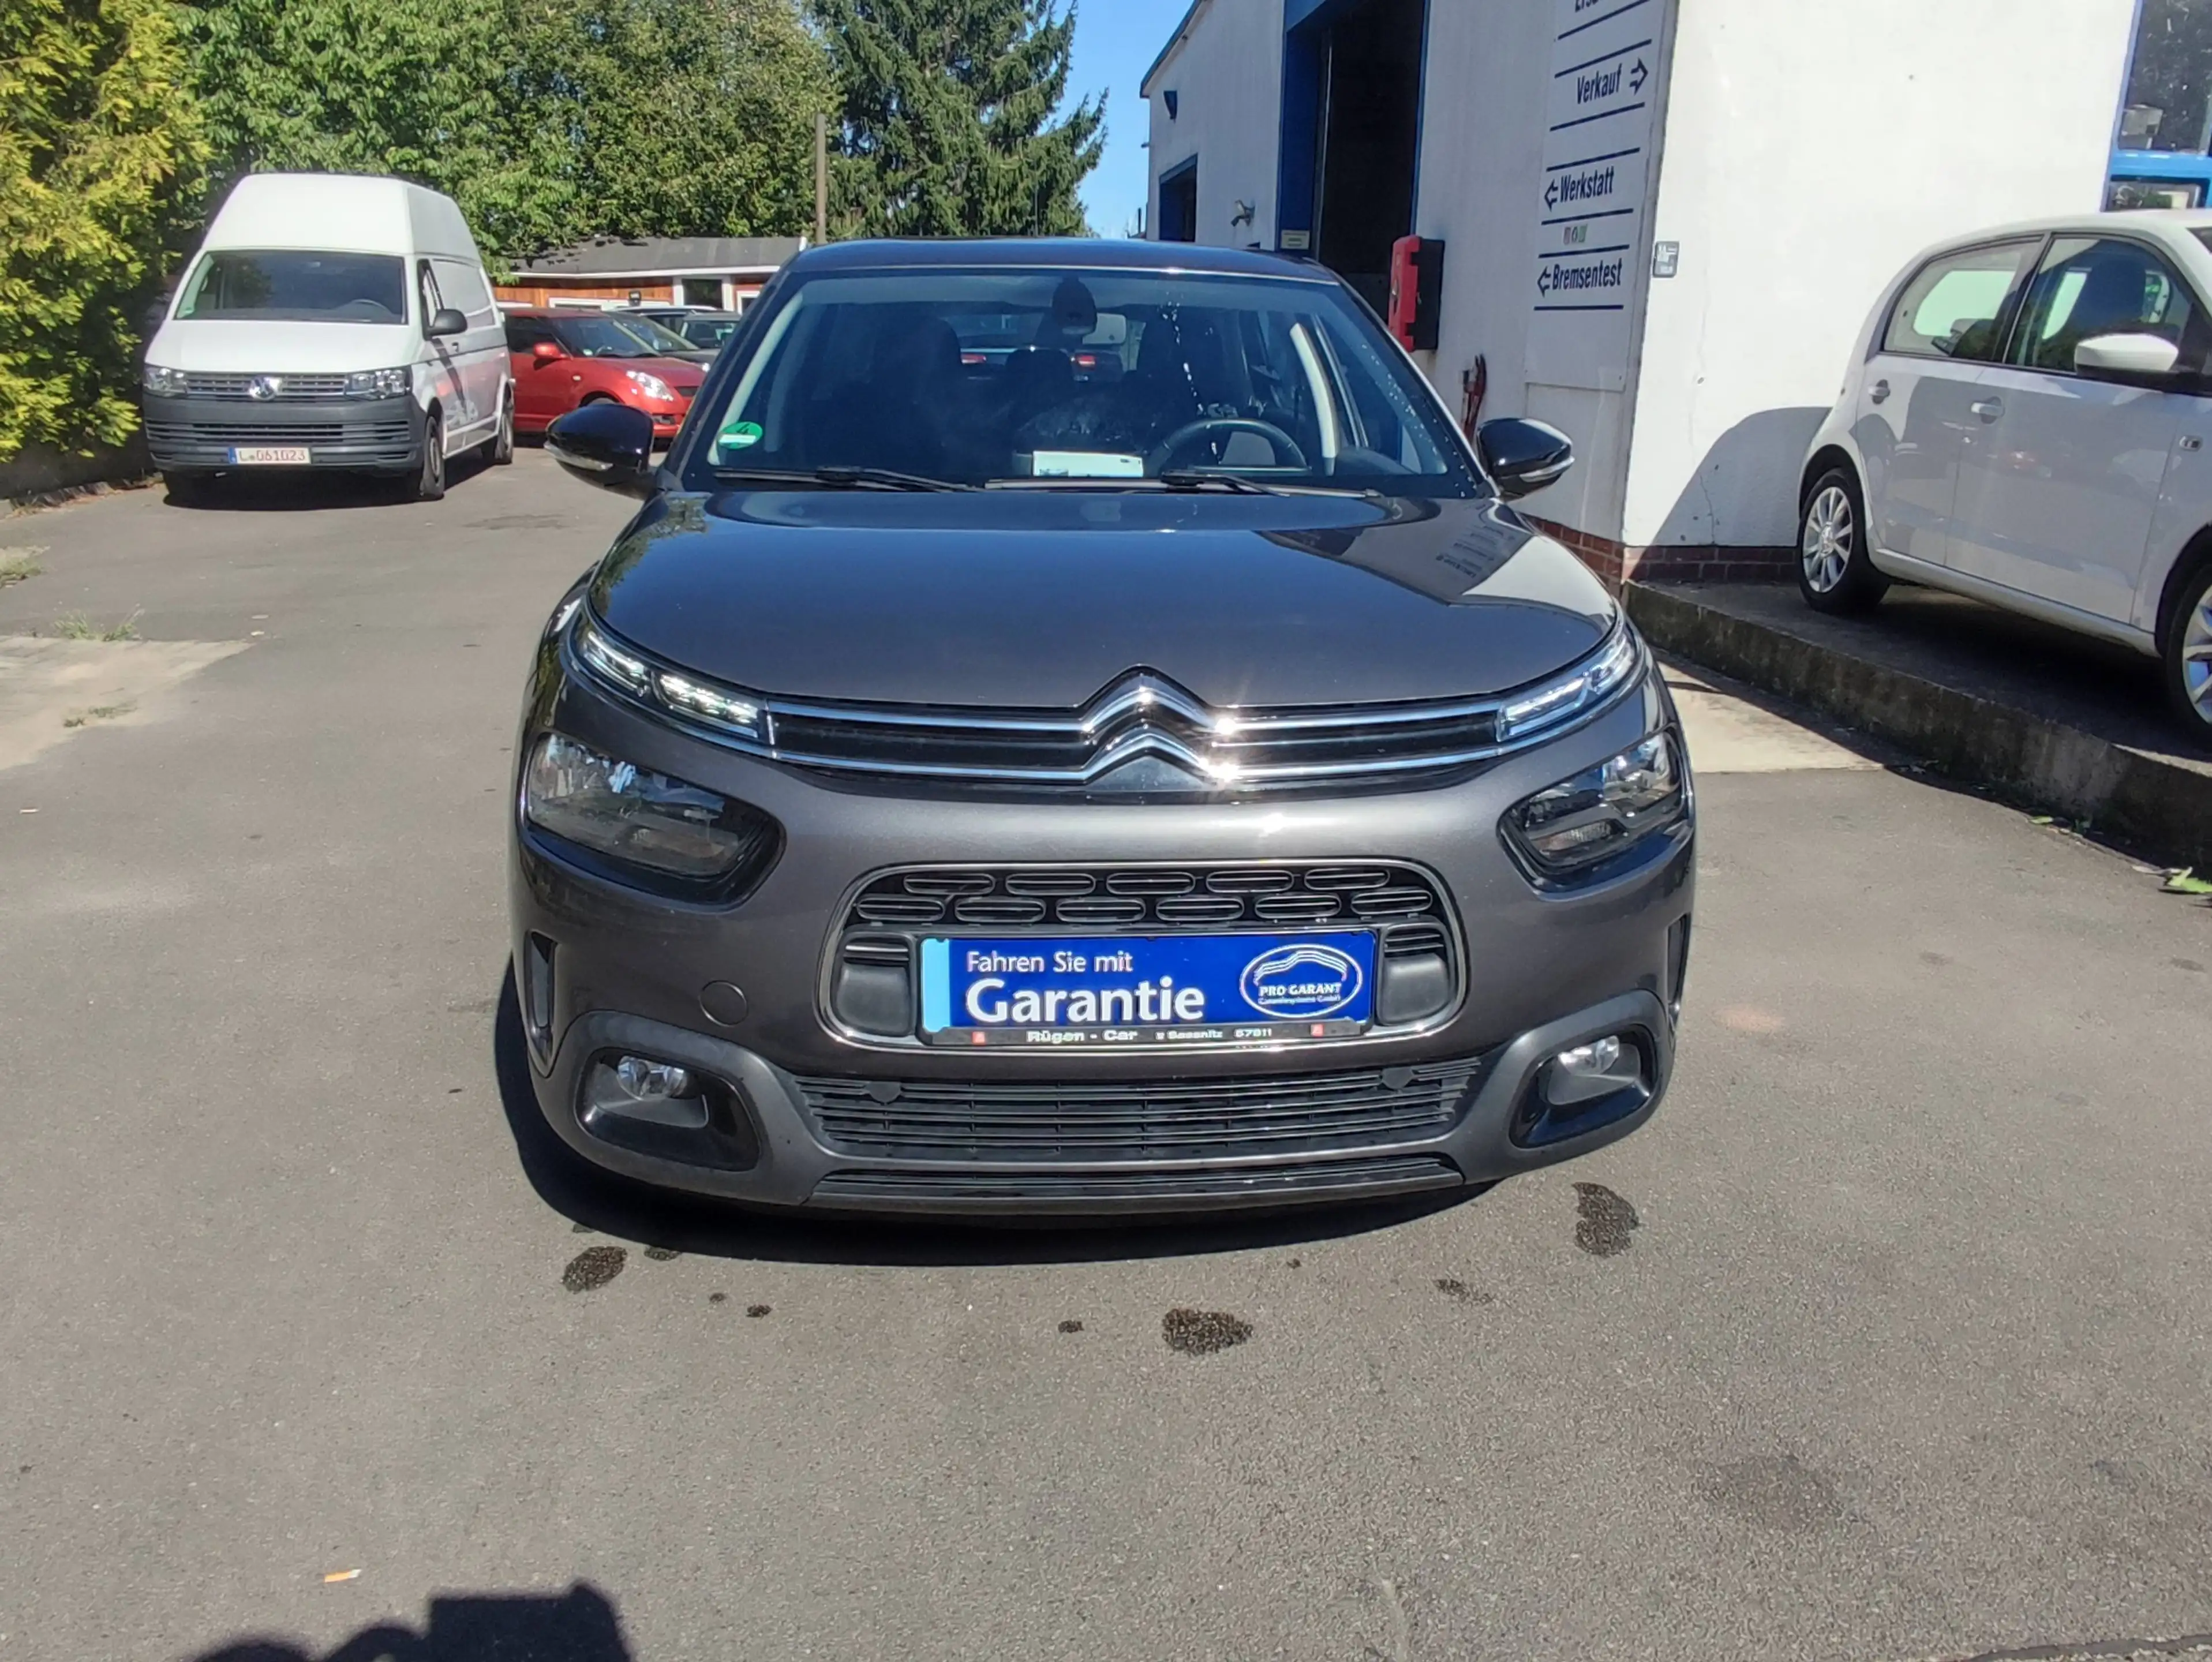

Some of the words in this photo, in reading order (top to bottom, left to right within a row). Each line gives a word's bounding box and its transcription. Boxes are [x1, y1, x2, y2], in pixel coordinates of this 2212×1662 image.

[1577, 63, 1622, 104] Verkauf
[1560, 166, 1614, 203] Werkstatt
[1552, 258, 1622, 290] Bremsentest
[967, 951, 1044, 972] Fahren
[1053, 951, 1086, 972] Sie
[1094, 950, 1133, 972] mit
[966, 975, 1204, 1023] Garantie
[1259, 985, 1286, 996] PRO
[1288, 982, 1341, 995] GARANT
[1027, 1030, 1085, 1044] Rügen
[1103, 1029, 1137, 1041] Car
